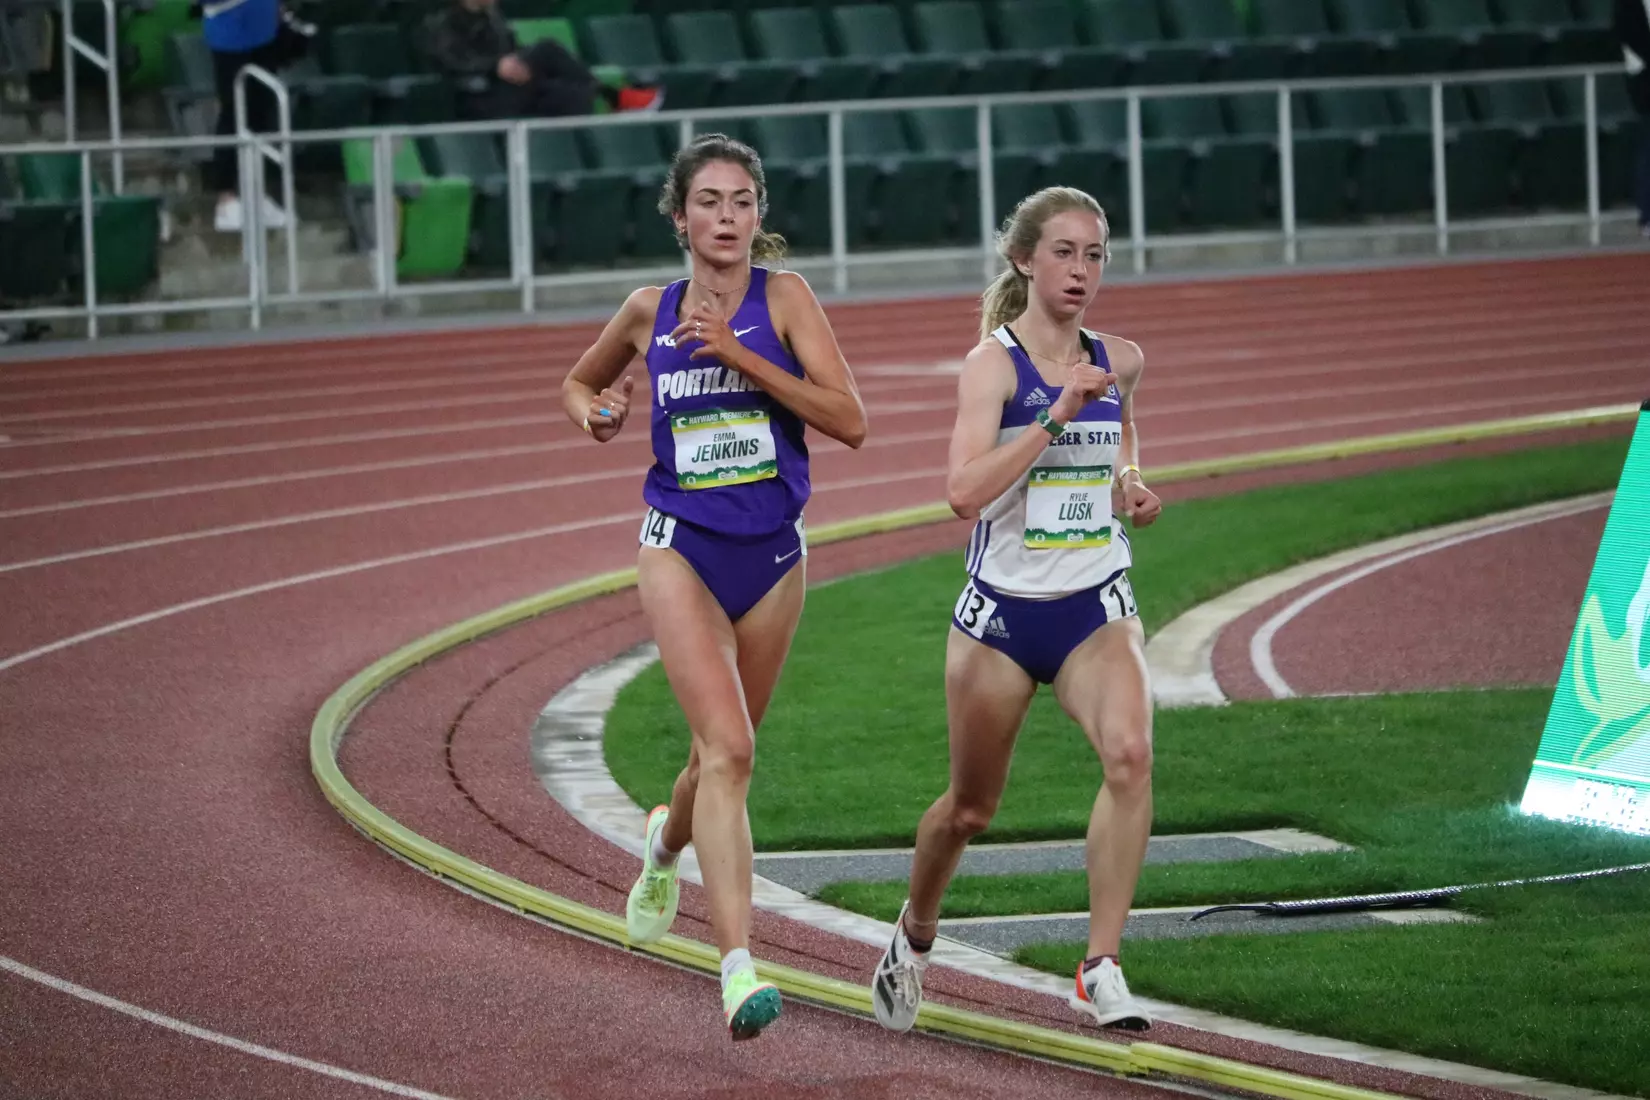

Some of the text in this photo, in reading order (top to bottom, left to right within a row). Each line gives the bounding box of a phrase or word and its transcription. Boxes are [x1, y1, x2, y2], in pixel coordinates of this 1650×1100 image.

[658, 366, 764, 407] PORTLAN
[1023, 399, 1051, 407] adidas
[688, 411, 752, 425] HAYWARD PREMIERE
[713, 432, 736, 442] EMMA
[691, 438, 759, 463] JENKINS
[1047, 471, 1078, 480] HAYWARD
[1069, 492, 1089, 502] RYLIE
[1058, 502, 1094, 521] LUSK
[644, 507, 667, 545] 14
[959, 586, 985, 629] 13
